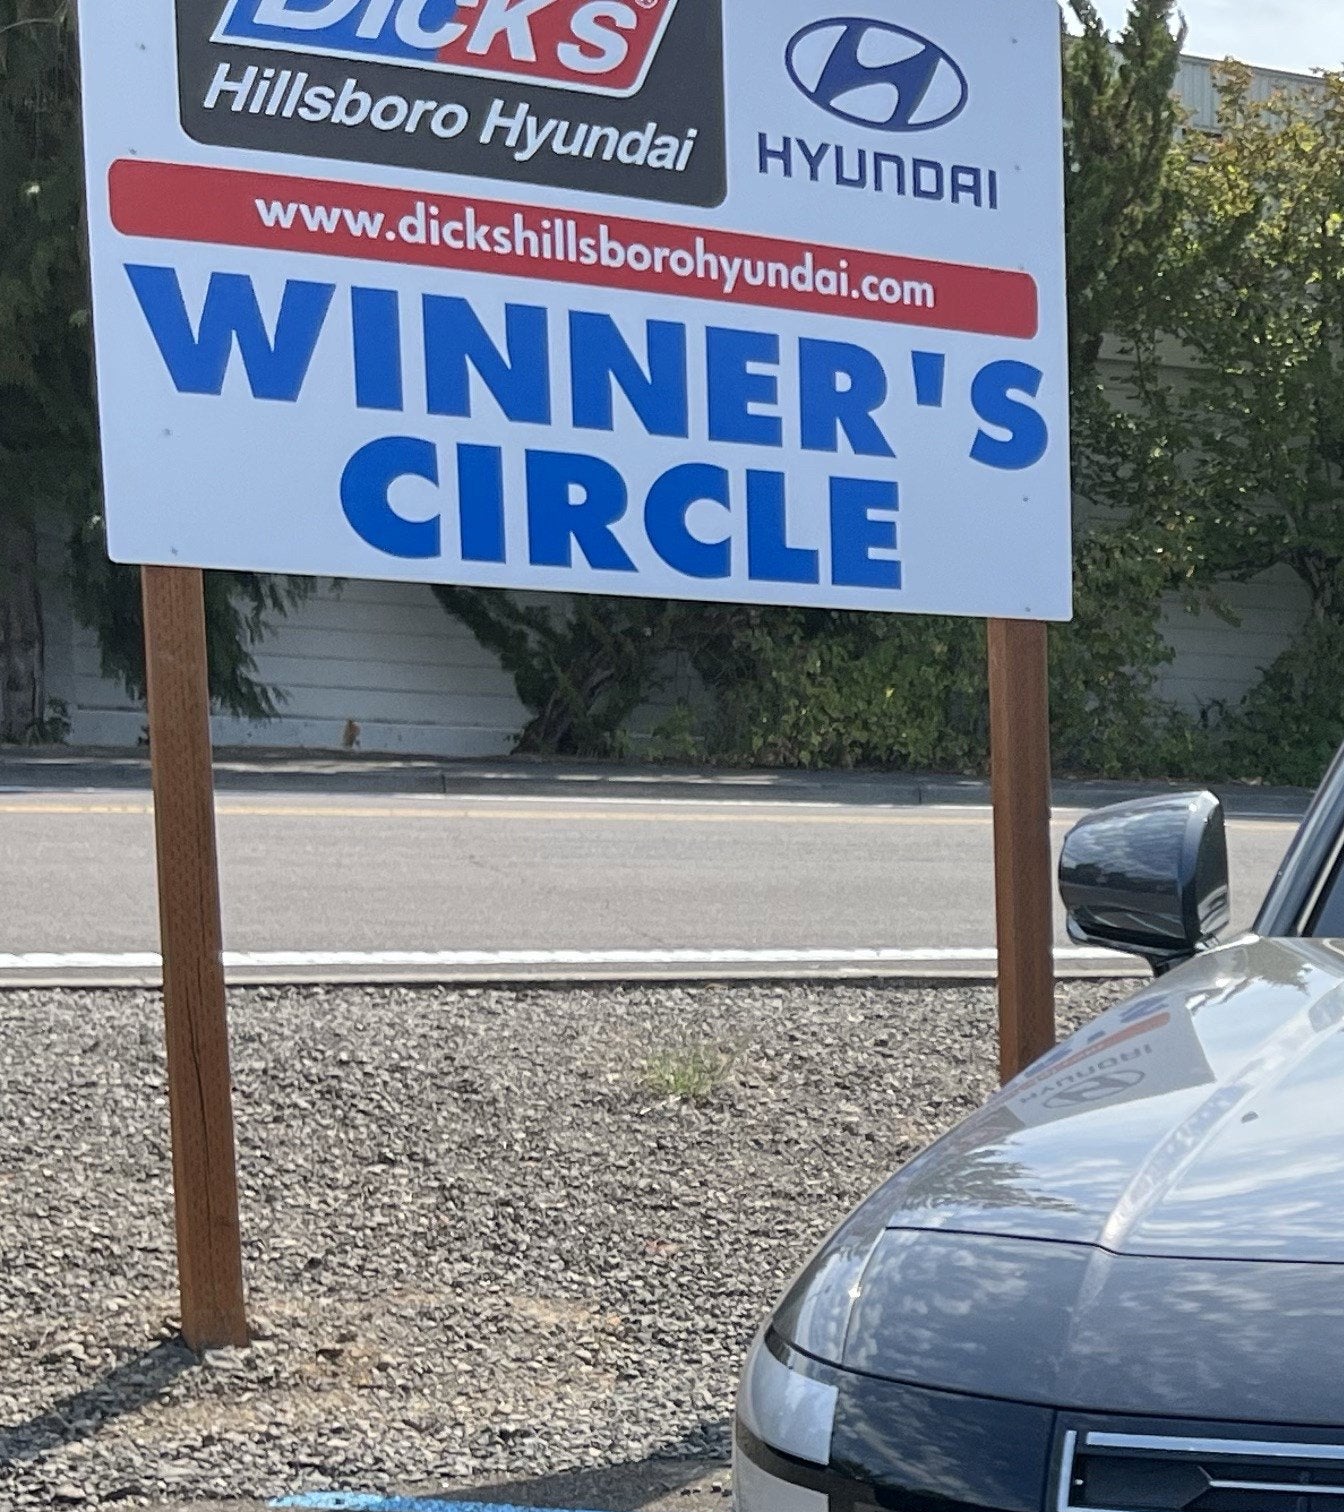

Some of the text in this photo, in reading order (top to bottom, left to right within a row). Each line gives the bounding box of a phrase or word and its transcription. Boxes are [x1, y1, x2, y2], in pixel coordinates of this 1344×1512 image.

[252, 0, 638, 74] cks
[203, 63, 698, 172] Hillsboro Hyundai
[758, 132, 998, 210] HYUNDAI
[255, 199, 935, 309] www.dickshillsborohyundai.com
[123, 262, 1049, 471] WINNER'S
[340, 434, 902, 590] CIRCLE
